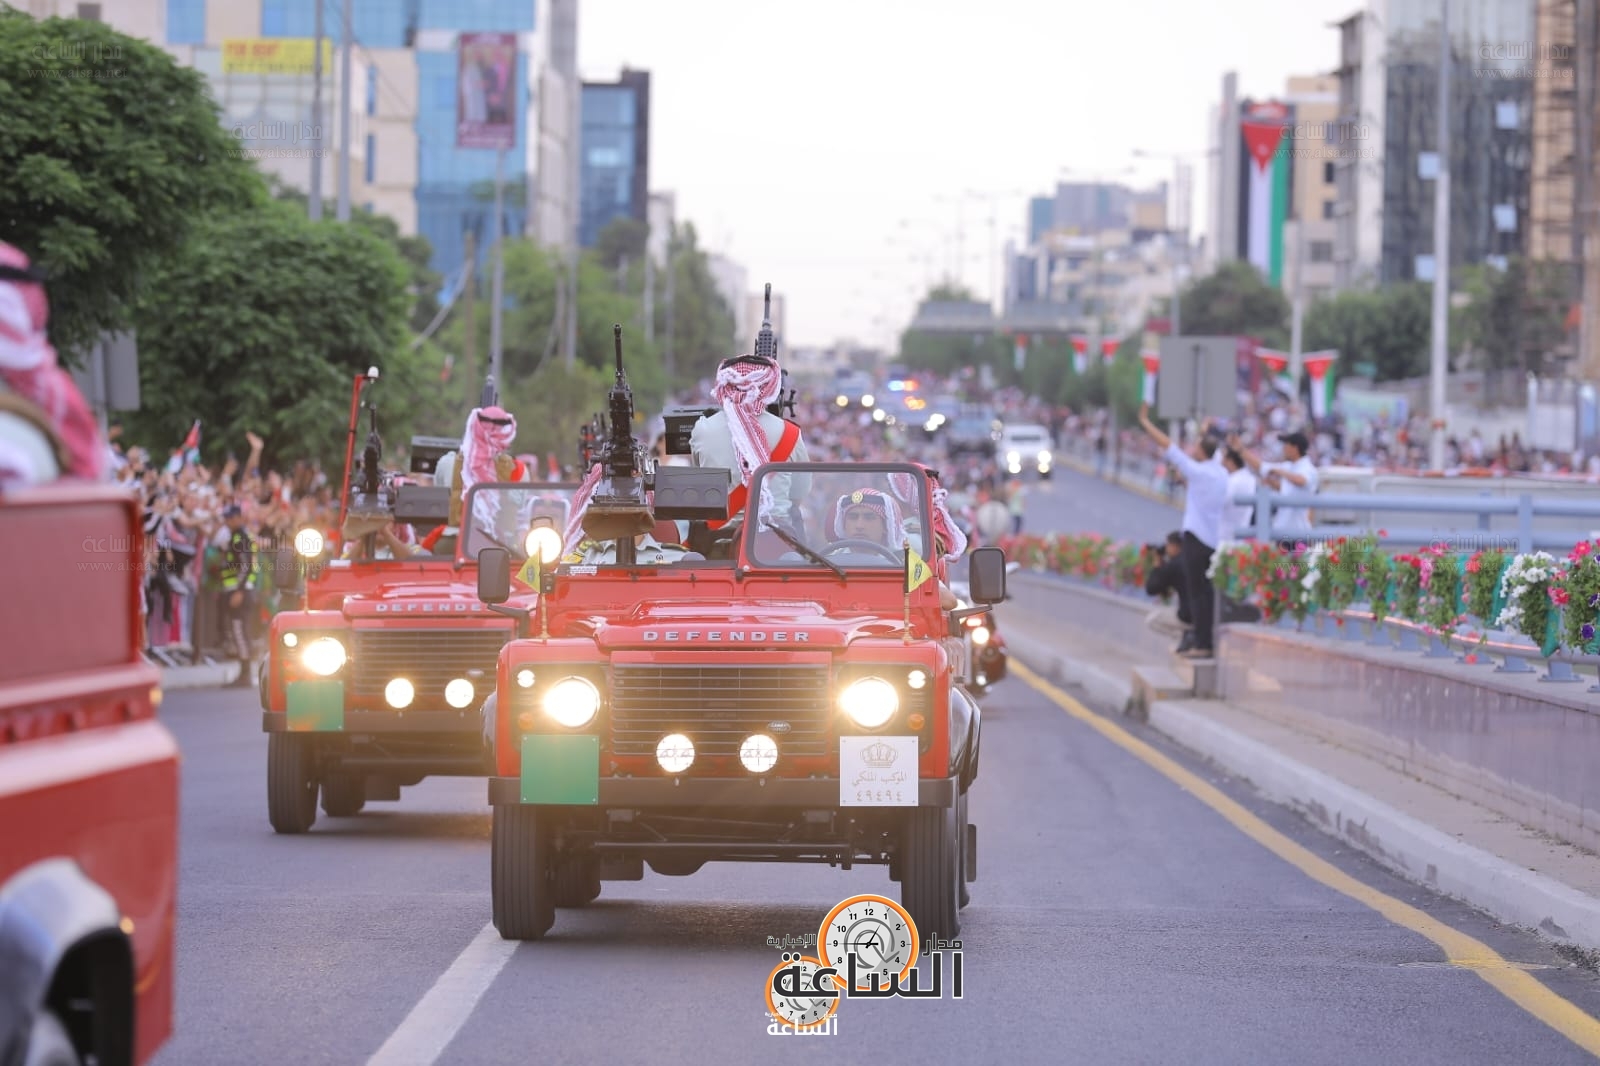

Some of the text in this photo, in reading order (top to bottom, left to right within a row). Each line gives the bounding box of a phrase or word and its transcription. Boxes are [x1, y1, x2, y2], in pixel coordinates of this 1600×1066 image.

[375, 603, 482, 612] DEFENDE
[642, 631, 810, 642] DEFENDER
[851, 770, 907, 787] الموكب الملكي
[856, 790, 904, 802] ٤٩٤٩٤
